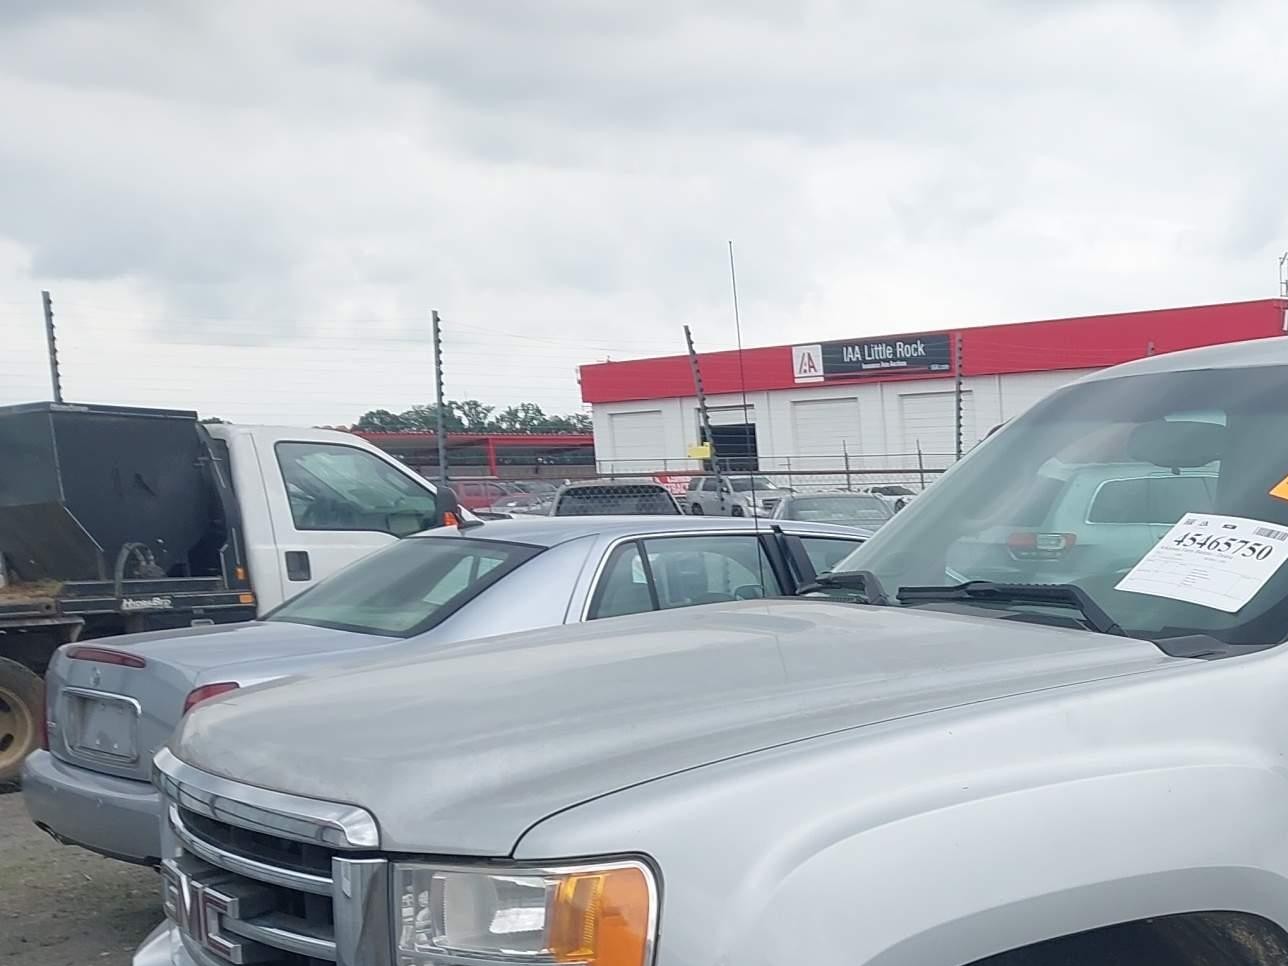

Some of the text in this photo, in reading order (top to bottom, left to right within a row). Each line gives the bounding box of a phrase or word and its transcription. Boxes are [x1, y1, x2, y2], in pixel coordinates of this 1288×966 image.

[842, 340, 926, 362] IAA Little Rock
[1173, 532, 1274, 561] 45465750
